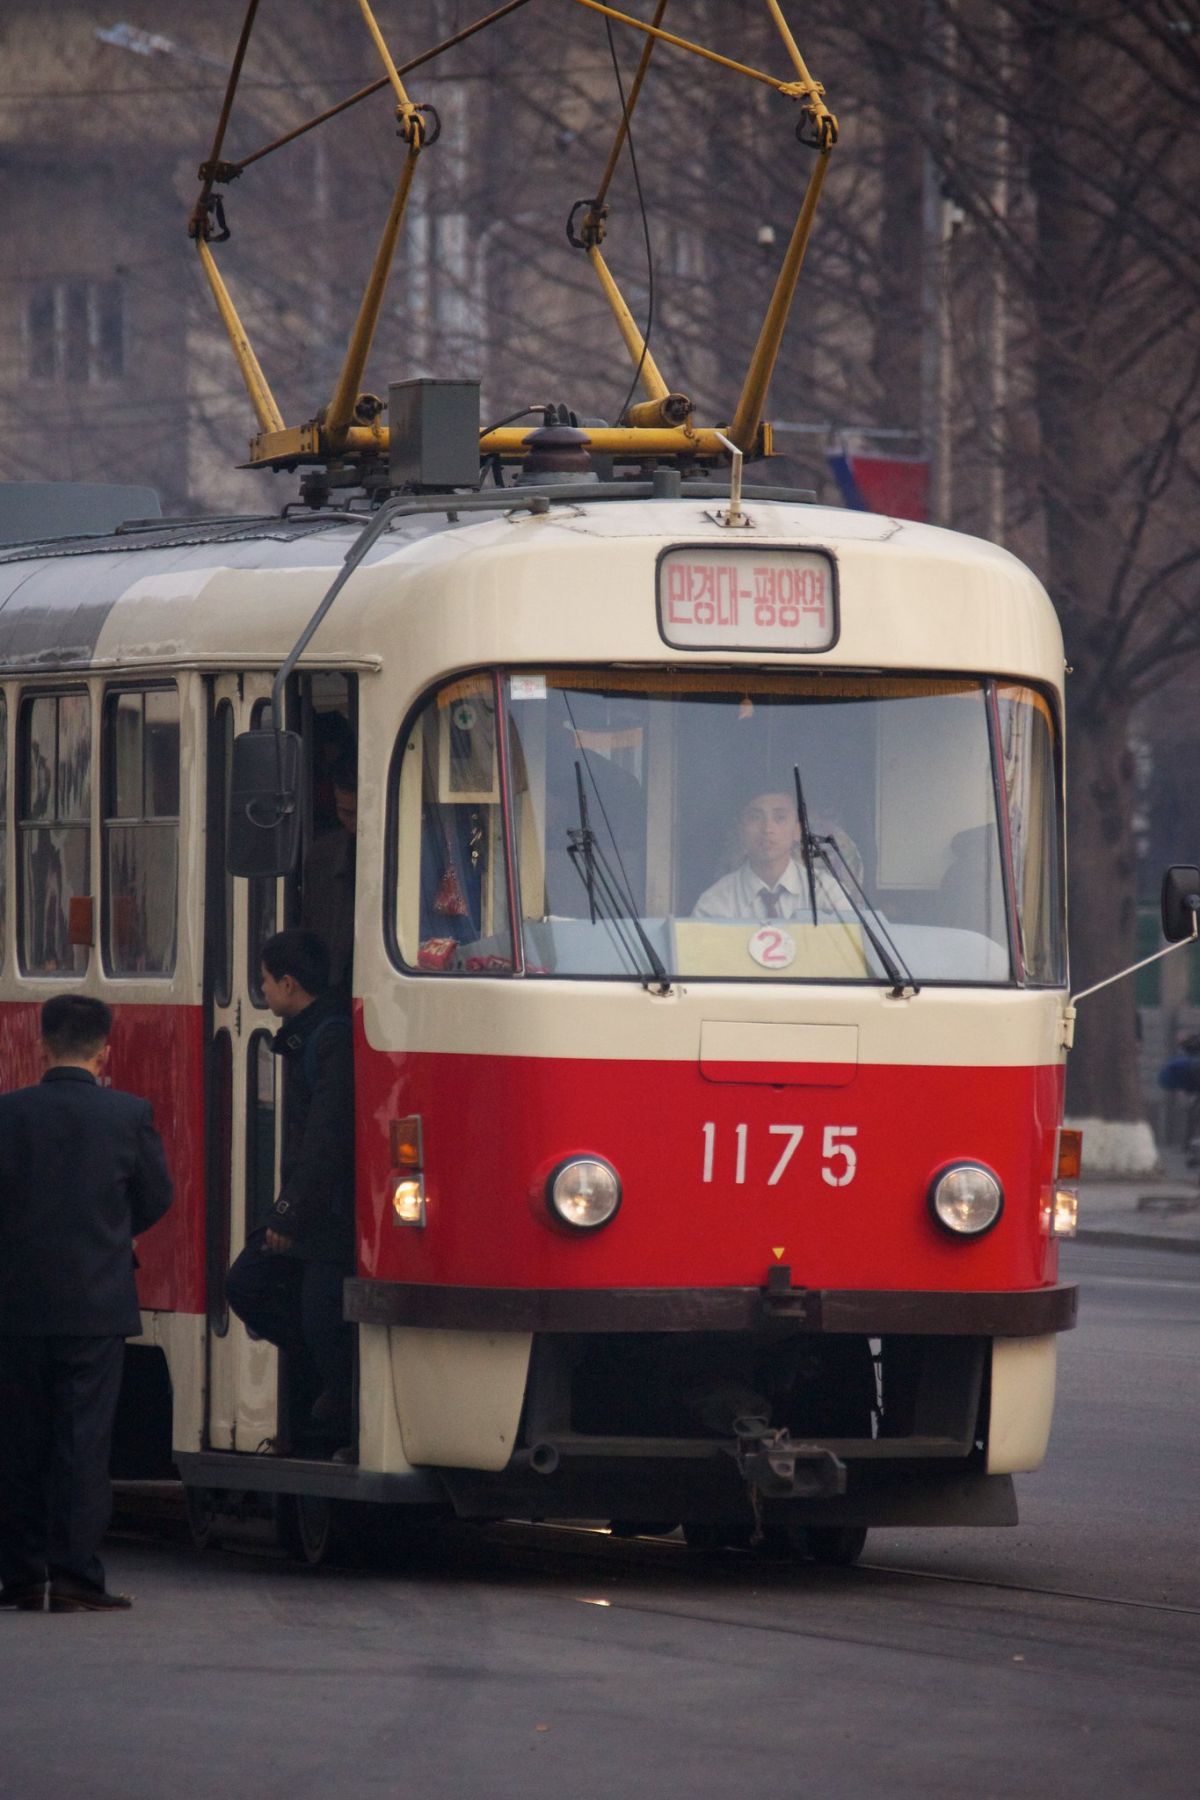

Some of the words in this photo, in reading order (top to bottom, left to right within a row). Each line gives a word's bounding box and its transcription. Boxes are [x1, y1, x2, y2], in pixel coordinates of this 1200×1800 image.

[667, 564, 826, 628] 만경대-평양역
[757, 930, 787, 962] 2
[702, 1122, 858, 1187] 1175
